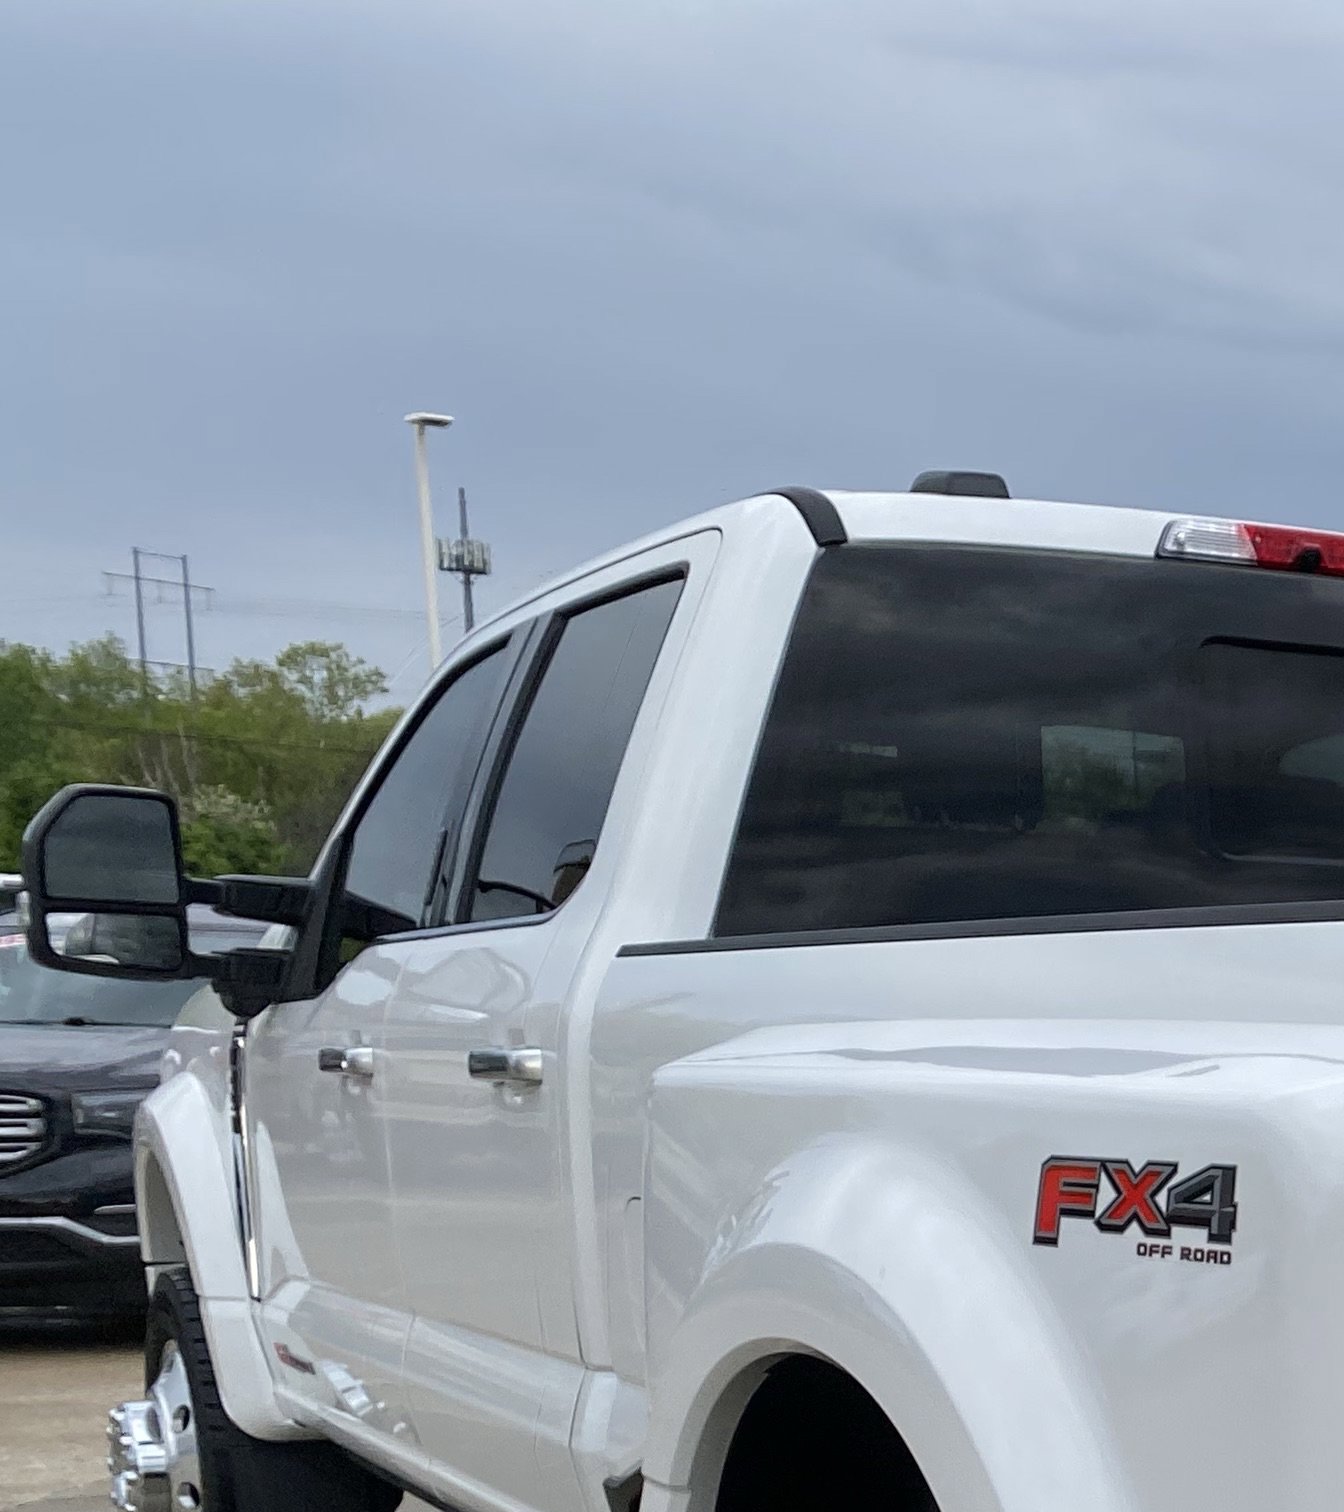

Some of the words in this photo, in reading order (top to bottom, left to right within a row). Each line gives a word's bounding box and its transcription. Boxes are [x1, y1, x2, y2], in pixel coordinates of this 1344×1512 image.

[1032, 1155, 1237, 1247] FX4
[1136, 1243, 1173, 1259] OFF
[1180, 1246, 1232, 1265] ROAD
